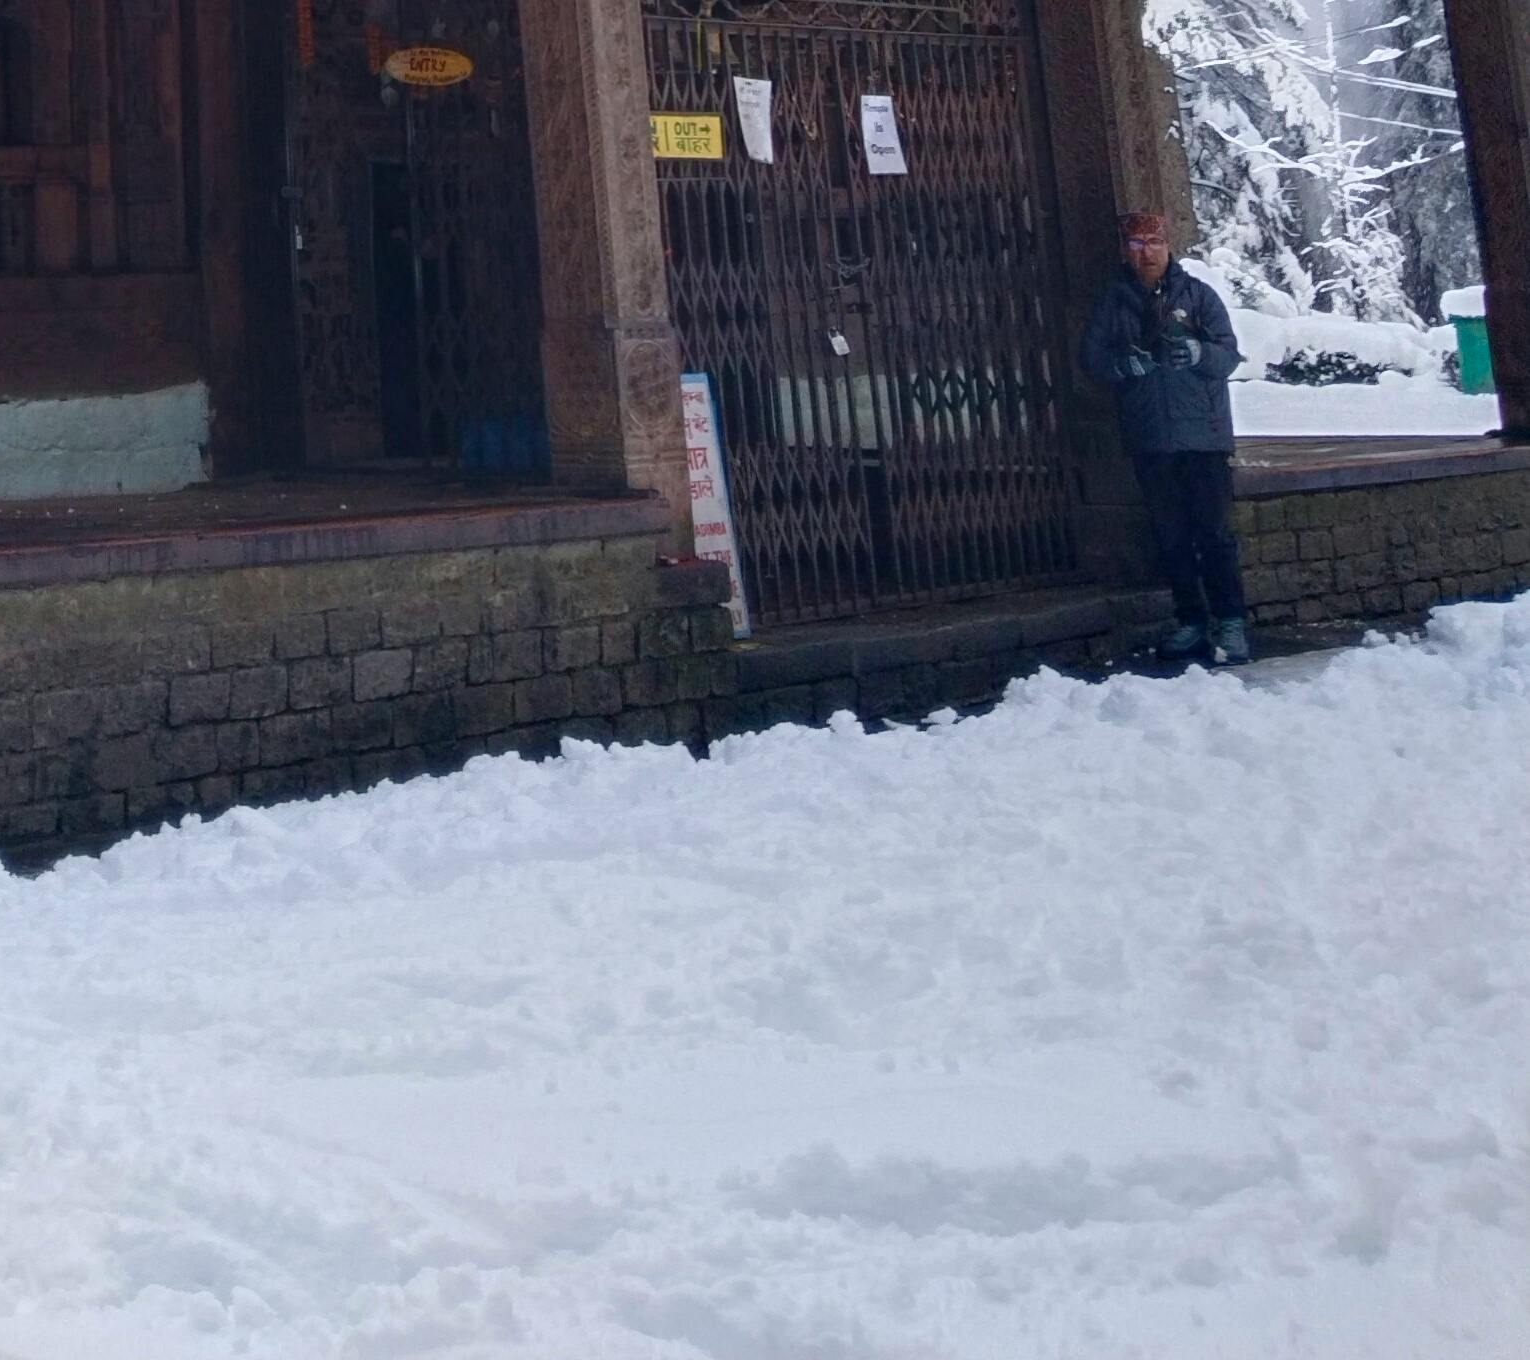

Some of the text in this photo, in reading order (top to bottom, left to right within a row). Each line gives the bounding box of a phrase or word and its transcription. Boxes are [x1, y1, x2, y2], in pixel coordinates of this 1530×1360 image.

[410, 58, 446, 73] ENTRY
[674, 122, 696, 136] OUT
[675, 137, 711, 153] बाहर
[871, 144, 896, 156] Open
